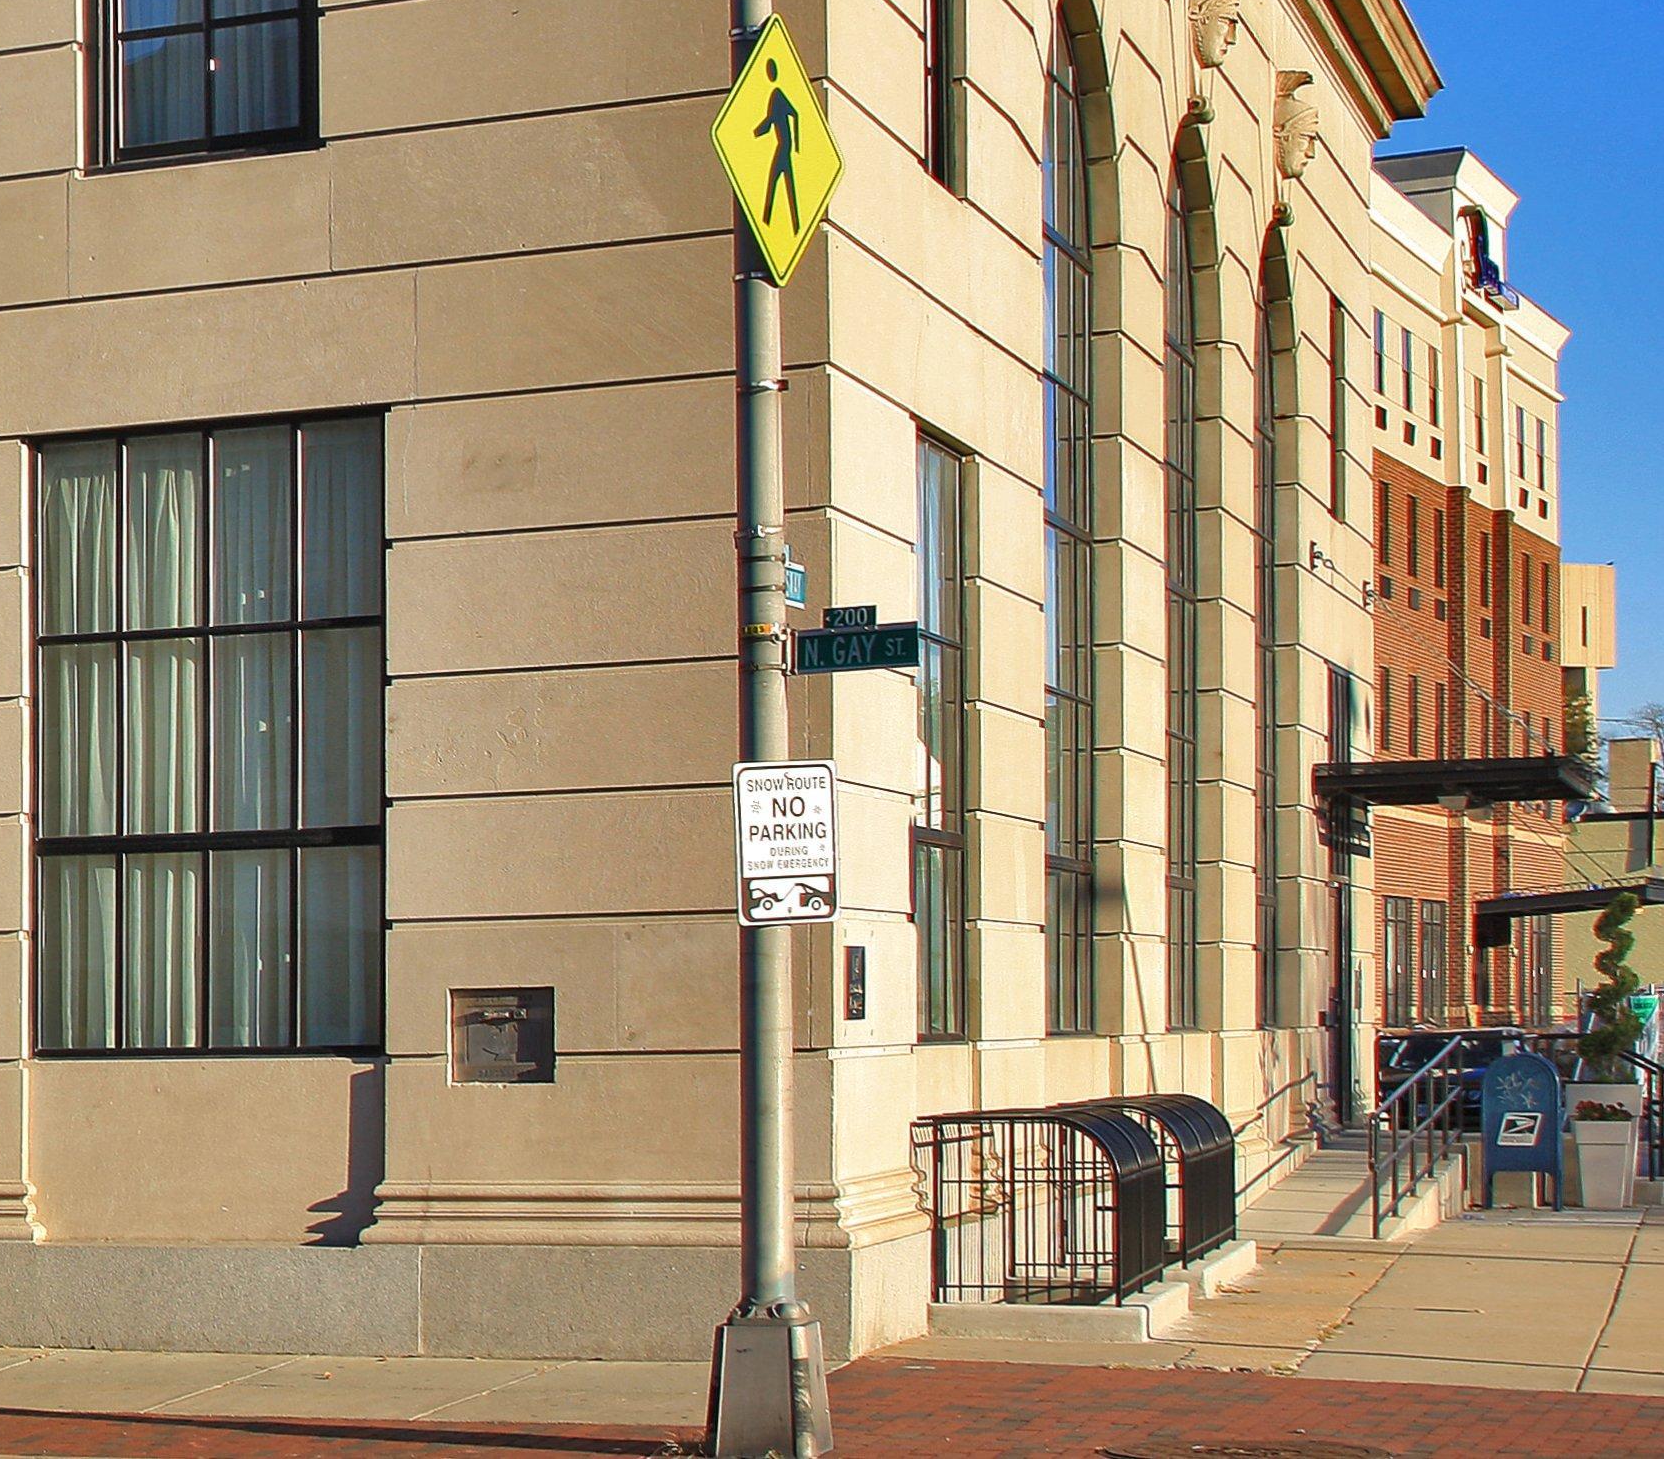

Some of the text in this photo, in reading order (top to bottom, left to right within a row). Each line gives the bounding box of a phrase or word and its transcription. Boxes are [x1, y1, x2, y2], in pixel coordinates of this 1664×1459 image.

[833, 607, 868, 627] 200
[804, 633, 907, 667] N. GAY ST.
[746, 777, 827, 793] SNOW ROUTE
[772, 796, 806, 818] NO
[749, 822, 827, 842] PARKING
[770, 845, 809, 857] DURING
[747, 857, 829, 871] SNOW EMERGENCY
